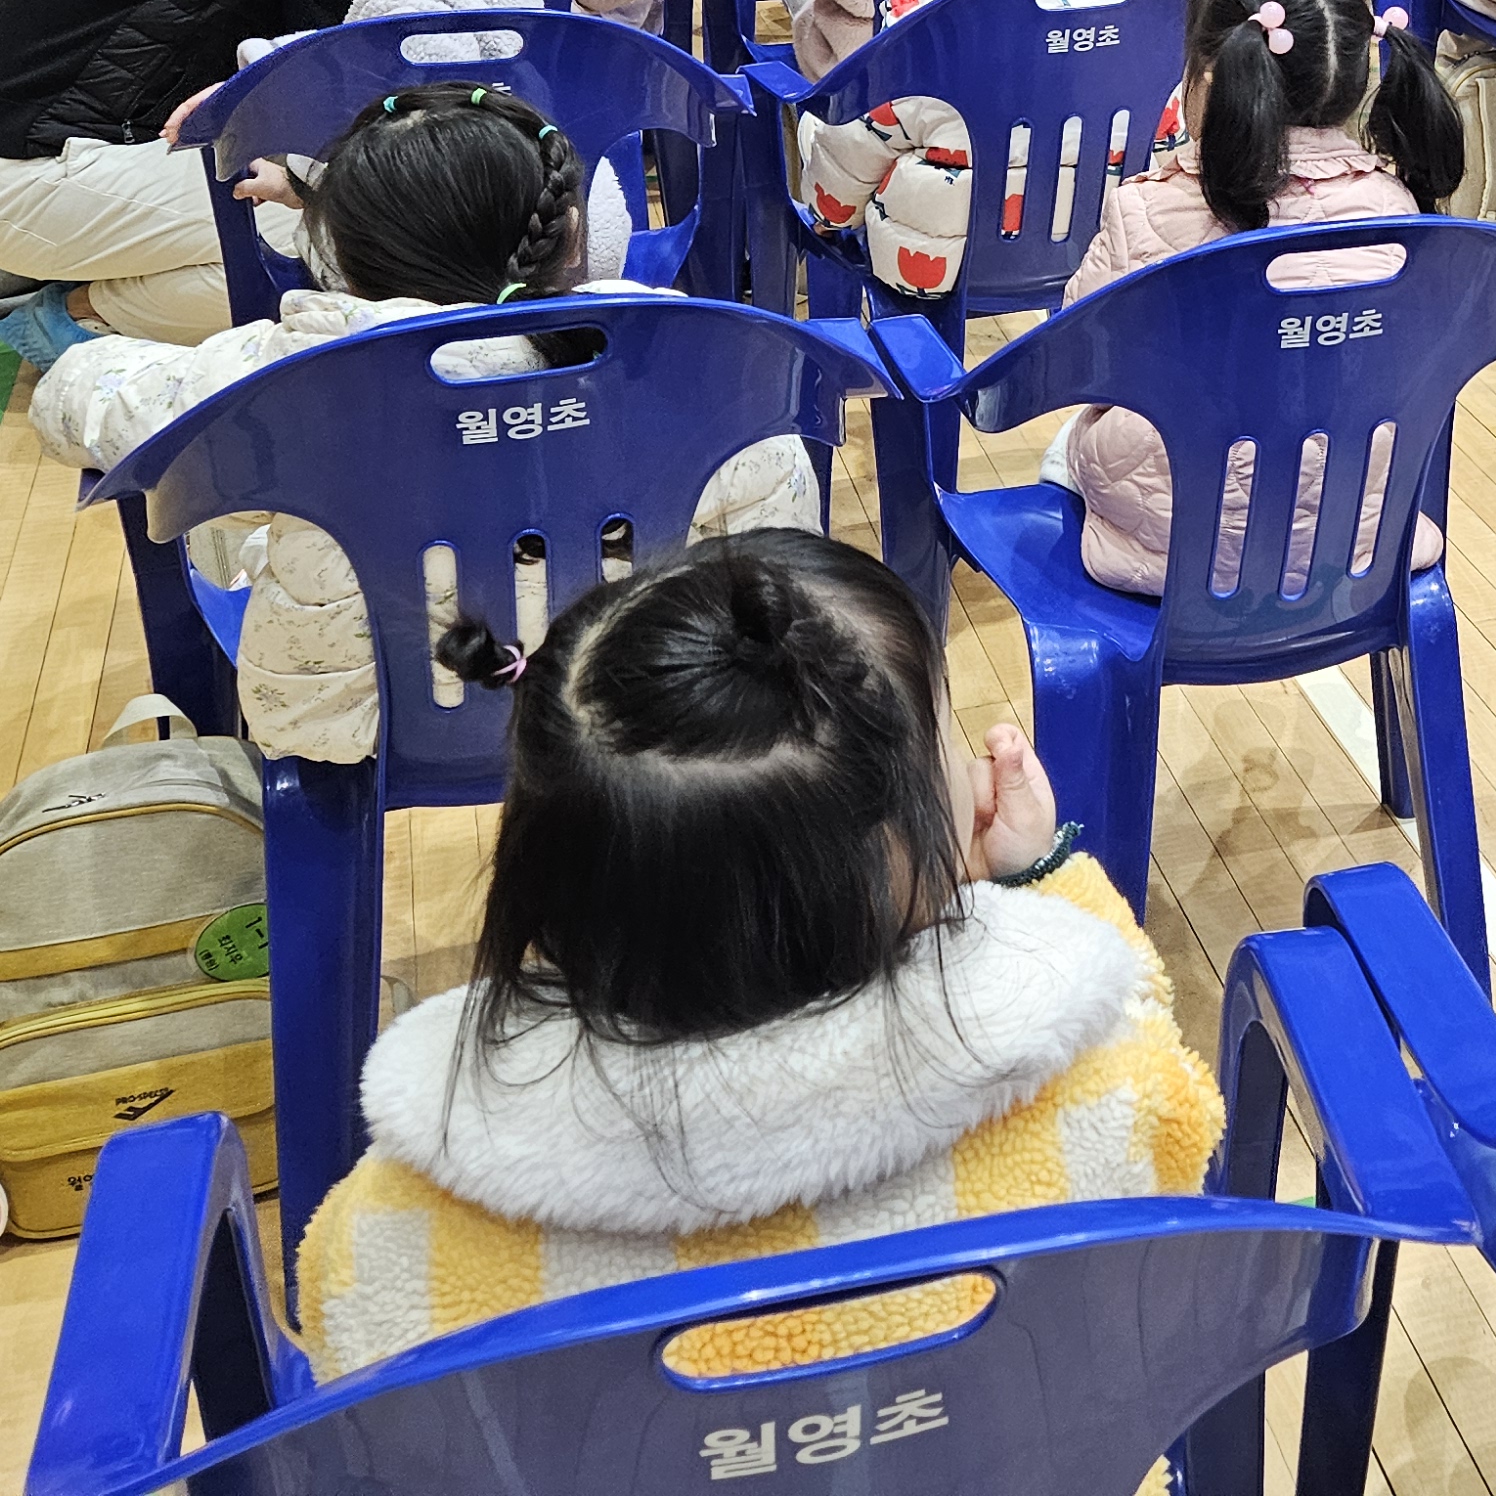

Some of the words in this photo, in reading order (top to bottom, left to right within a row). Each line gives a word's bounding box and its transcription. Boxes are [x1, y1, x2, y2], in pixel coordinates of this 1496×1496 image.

[1045, 25, 1121, 54] 월영초
[1277, 308, 1384, 349] 월영초
[455, 397, 591, 445] 월영초
[698, 1387, 950, 1481] 월영초
